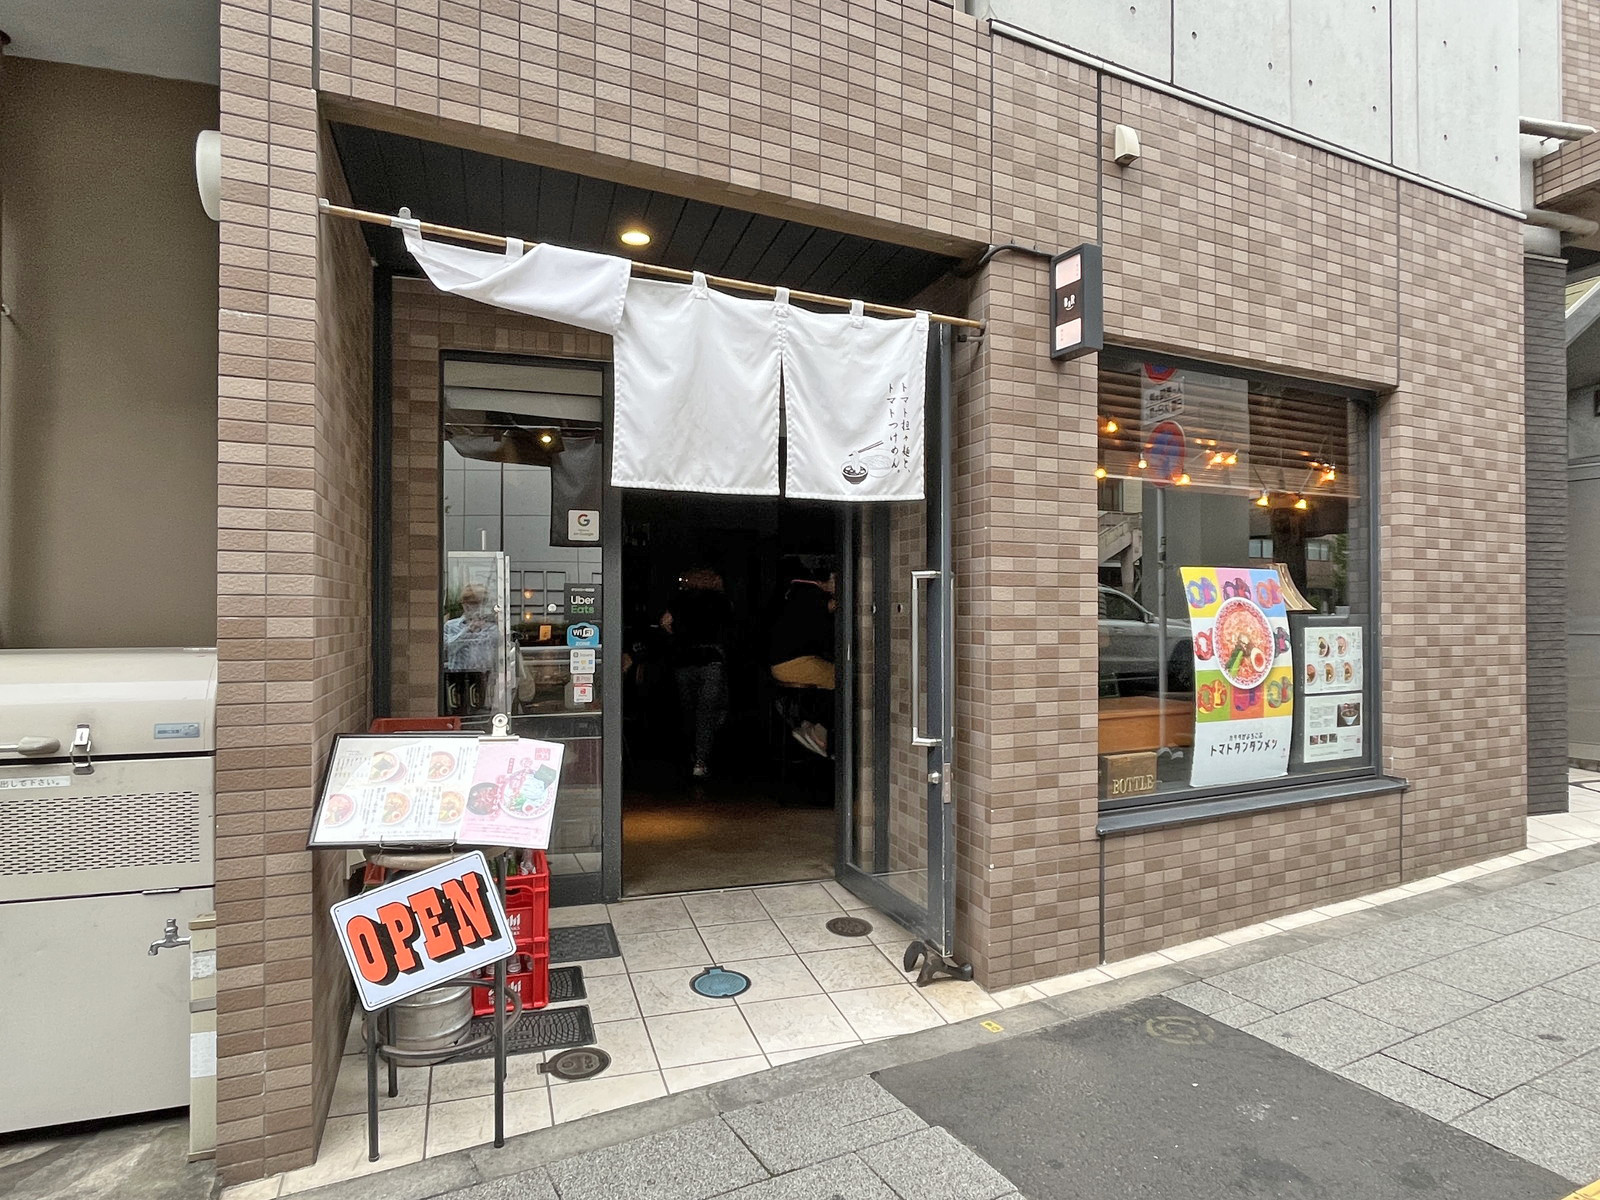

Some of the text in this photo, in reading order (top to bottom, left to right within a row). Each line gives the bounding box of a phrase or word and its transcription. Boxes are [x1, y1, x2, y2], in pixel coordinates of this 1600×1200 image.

[570, 595, 595, 605] Uber
[570, 605, 595, 614] Eats
[1210, 739, 1278, 757] トマトタンタンメン
[1112, 774, 1154, 795] BOTTLE
[346, 871, 502, 986] OPEN
